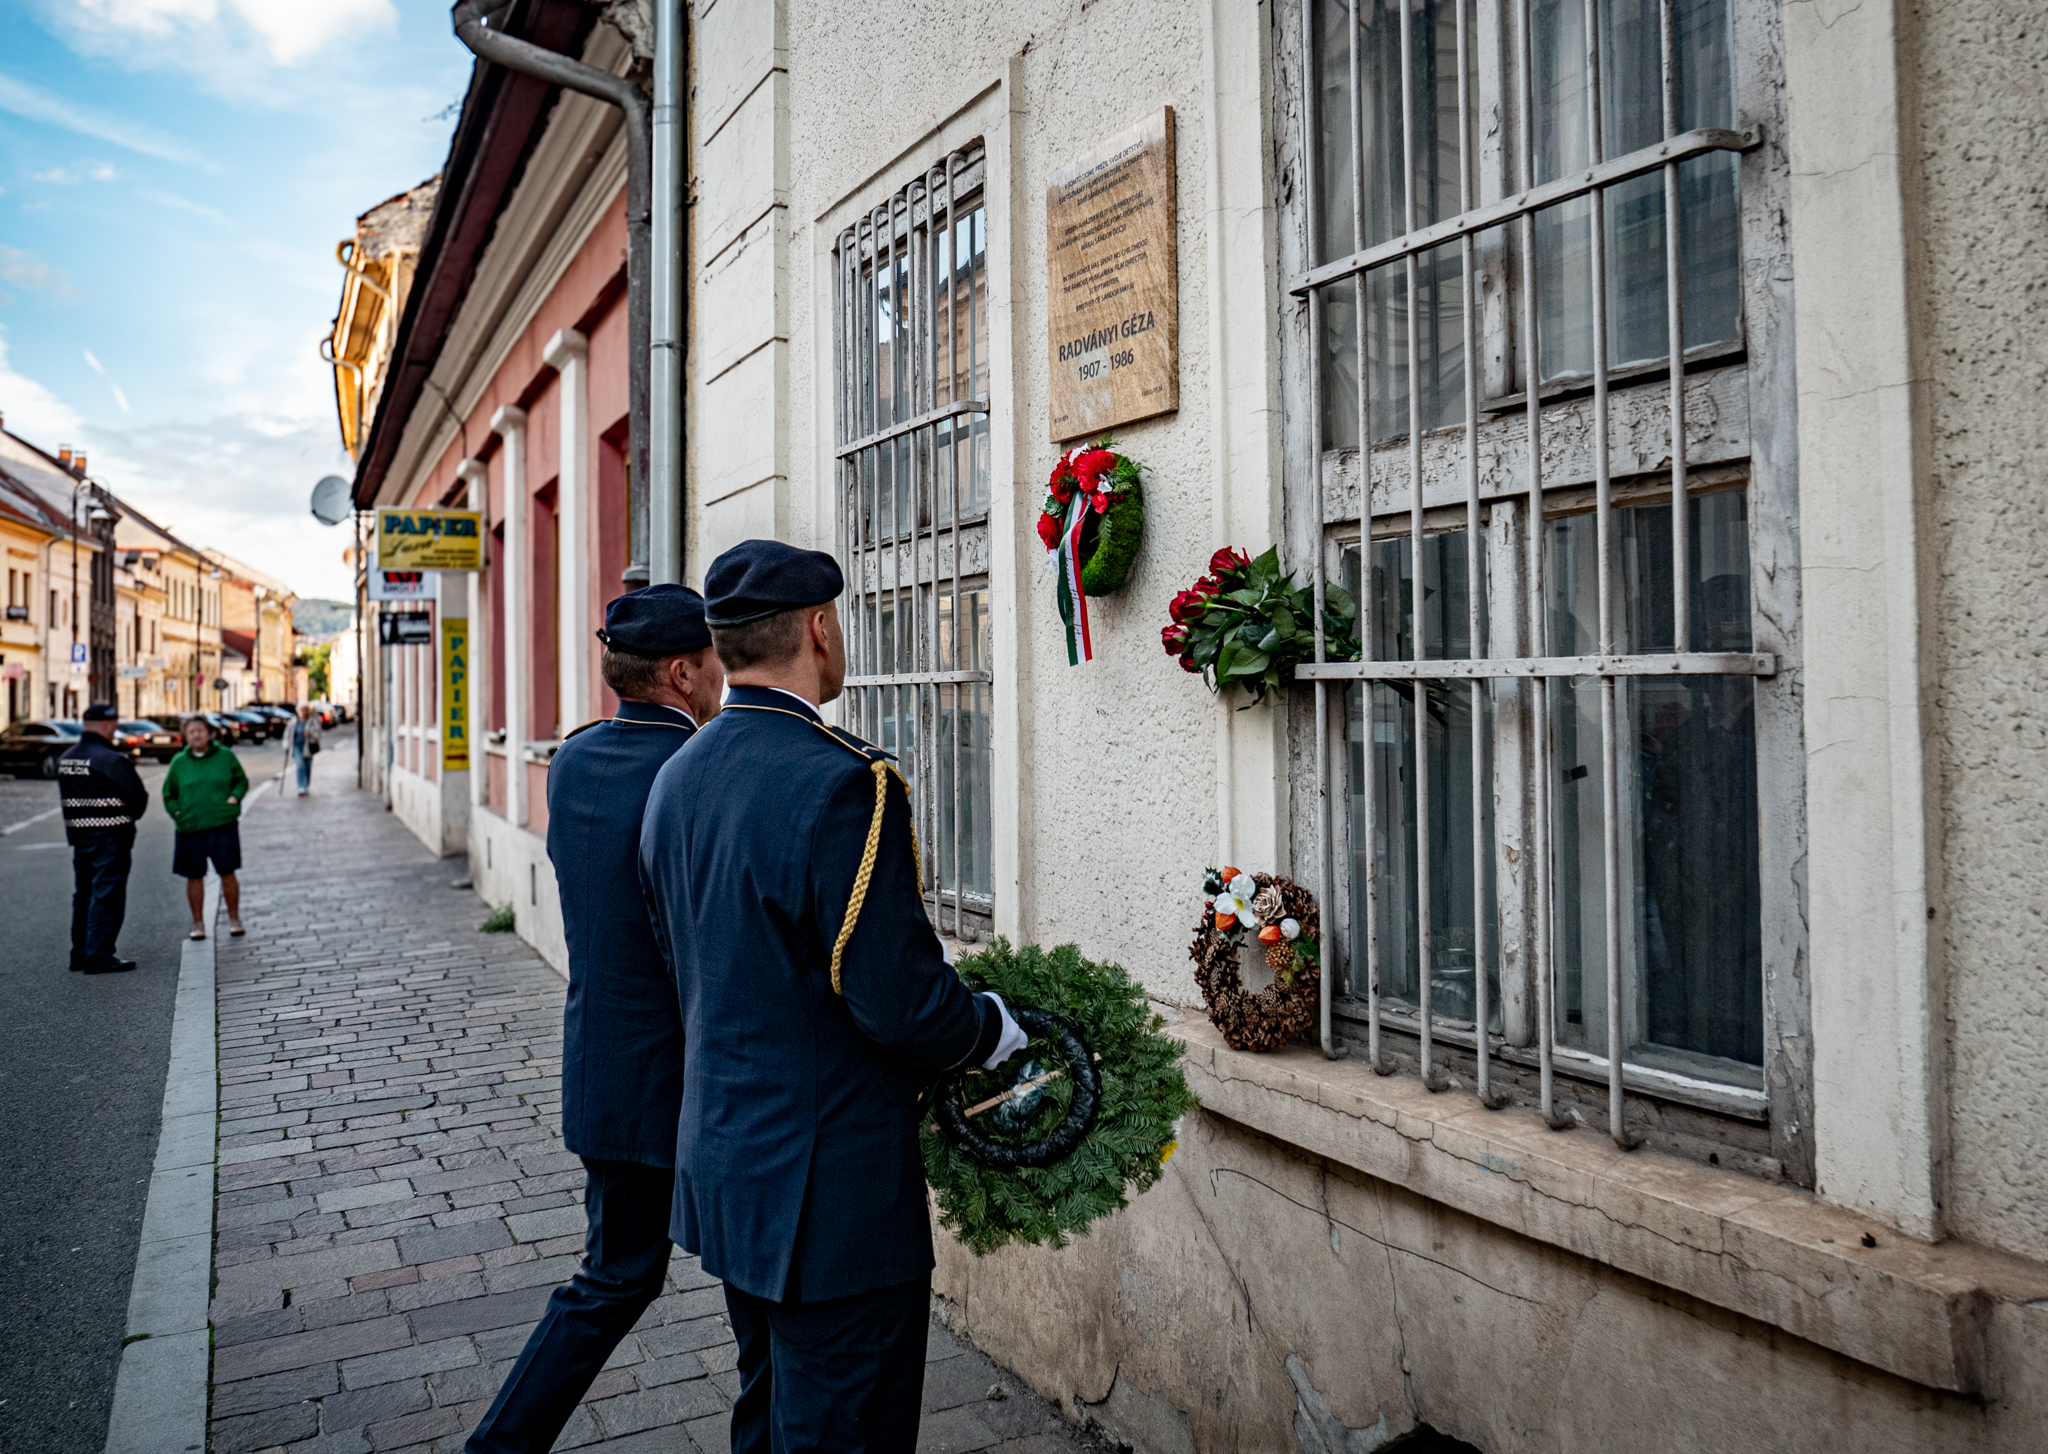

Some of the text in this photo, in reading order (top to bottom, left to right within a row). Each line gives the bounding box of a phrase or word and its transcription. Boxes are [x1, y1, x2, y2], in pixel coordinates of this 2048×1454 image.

[1109, 151, 1122, 163] SVOJE
[1123, 139, 1143, 157] DETSTVO
[1067, 271, 1076, 280] THIS
[1076, 264, 1090, 276] HOUSE
[1090, 261, 1100, 269] HAS
[1099, 254, 1113, 266] SPENT
[1121, 238, 1148, 256] CHILDHOOD
[1071, 277, 1088, 291] FAMOUS
[1088, 267, 1113, 282] HUNGARIAN
[1114, 261, 1124, 271] FILM
[1075, 299, 1094, 313] BROTHER
[1059, 311, 1155, 362] RADVÁNYI GÉZA
[1078, 360, 1100, 381] 1907
[1109, 348, 1134, 371] 1986
[384, 514, 477, 536] PAPIER
[450, 636, 465, 739] PAPIER
